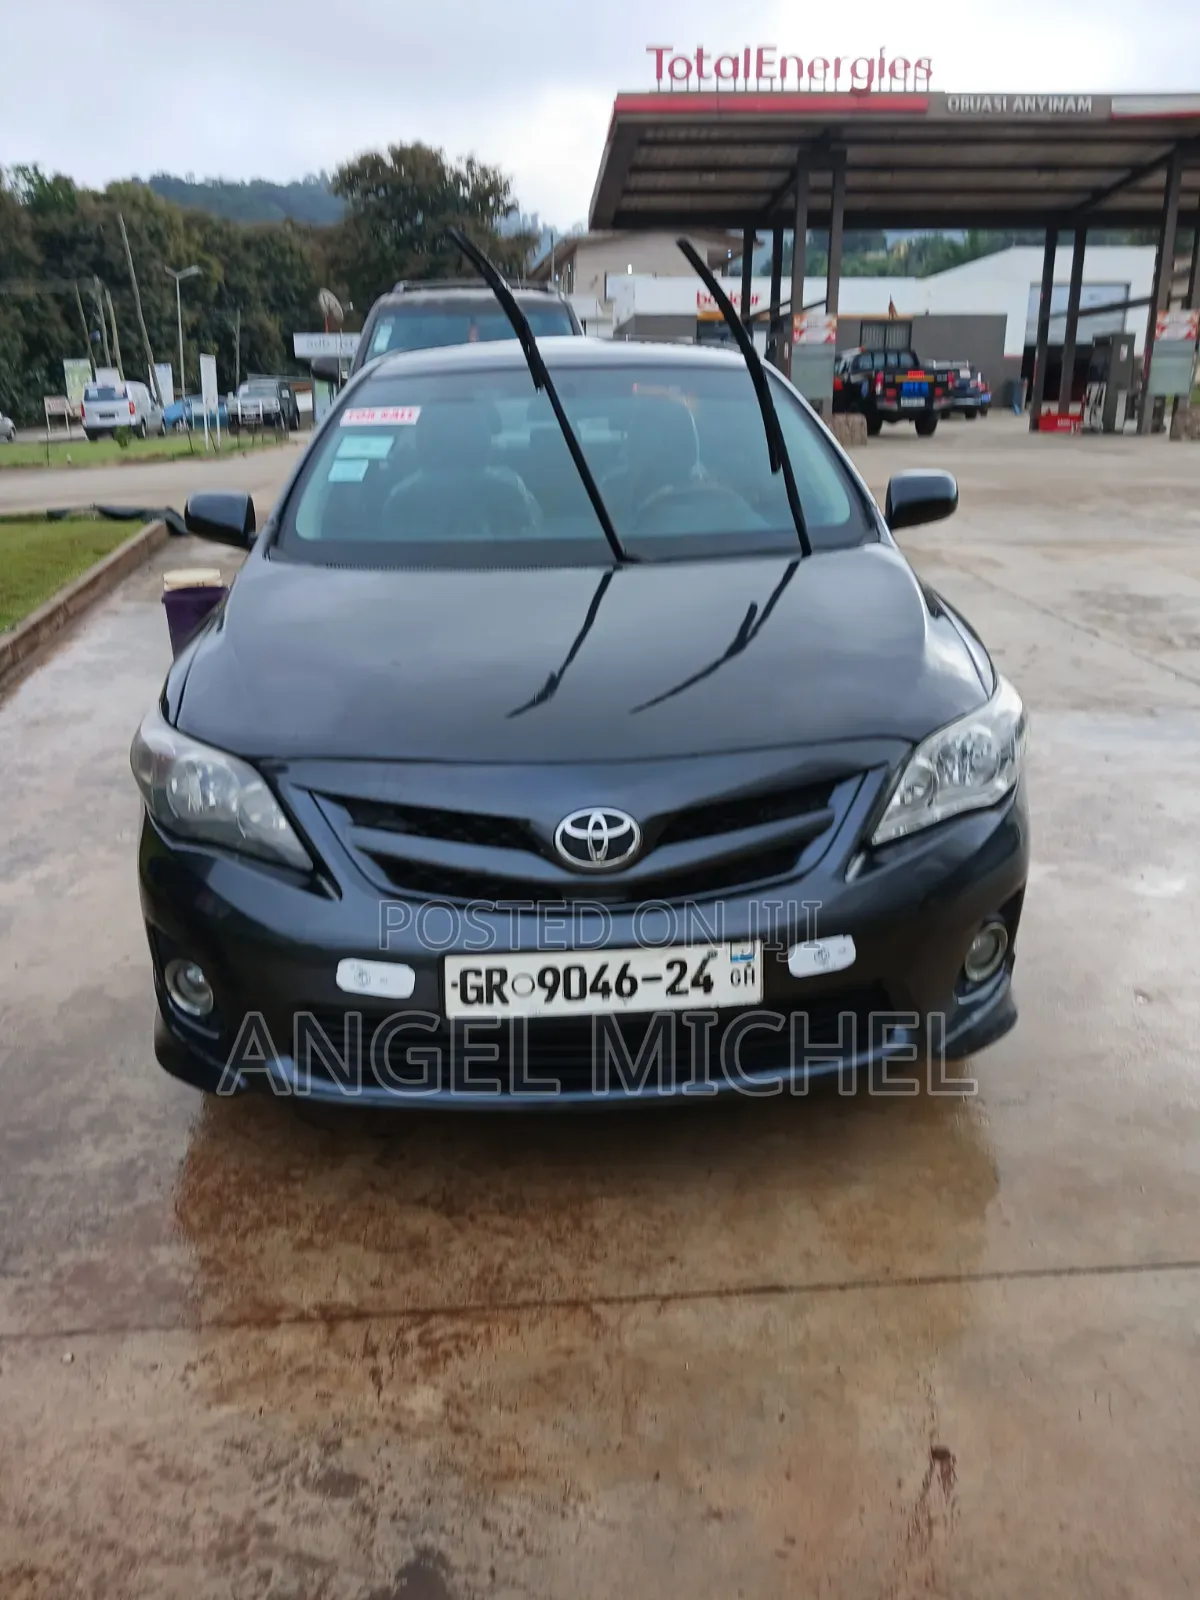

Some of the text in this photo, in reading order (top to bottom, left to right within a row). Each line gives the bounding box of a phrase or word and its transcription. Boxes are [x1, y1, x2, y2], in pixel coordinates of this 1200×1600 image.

[645, 45, 932, 96] TotalEnergies
[948, 96, 1092, 114] OBUASI ANYINAM
[459, 954, 716, 1005] GR 9046-24
